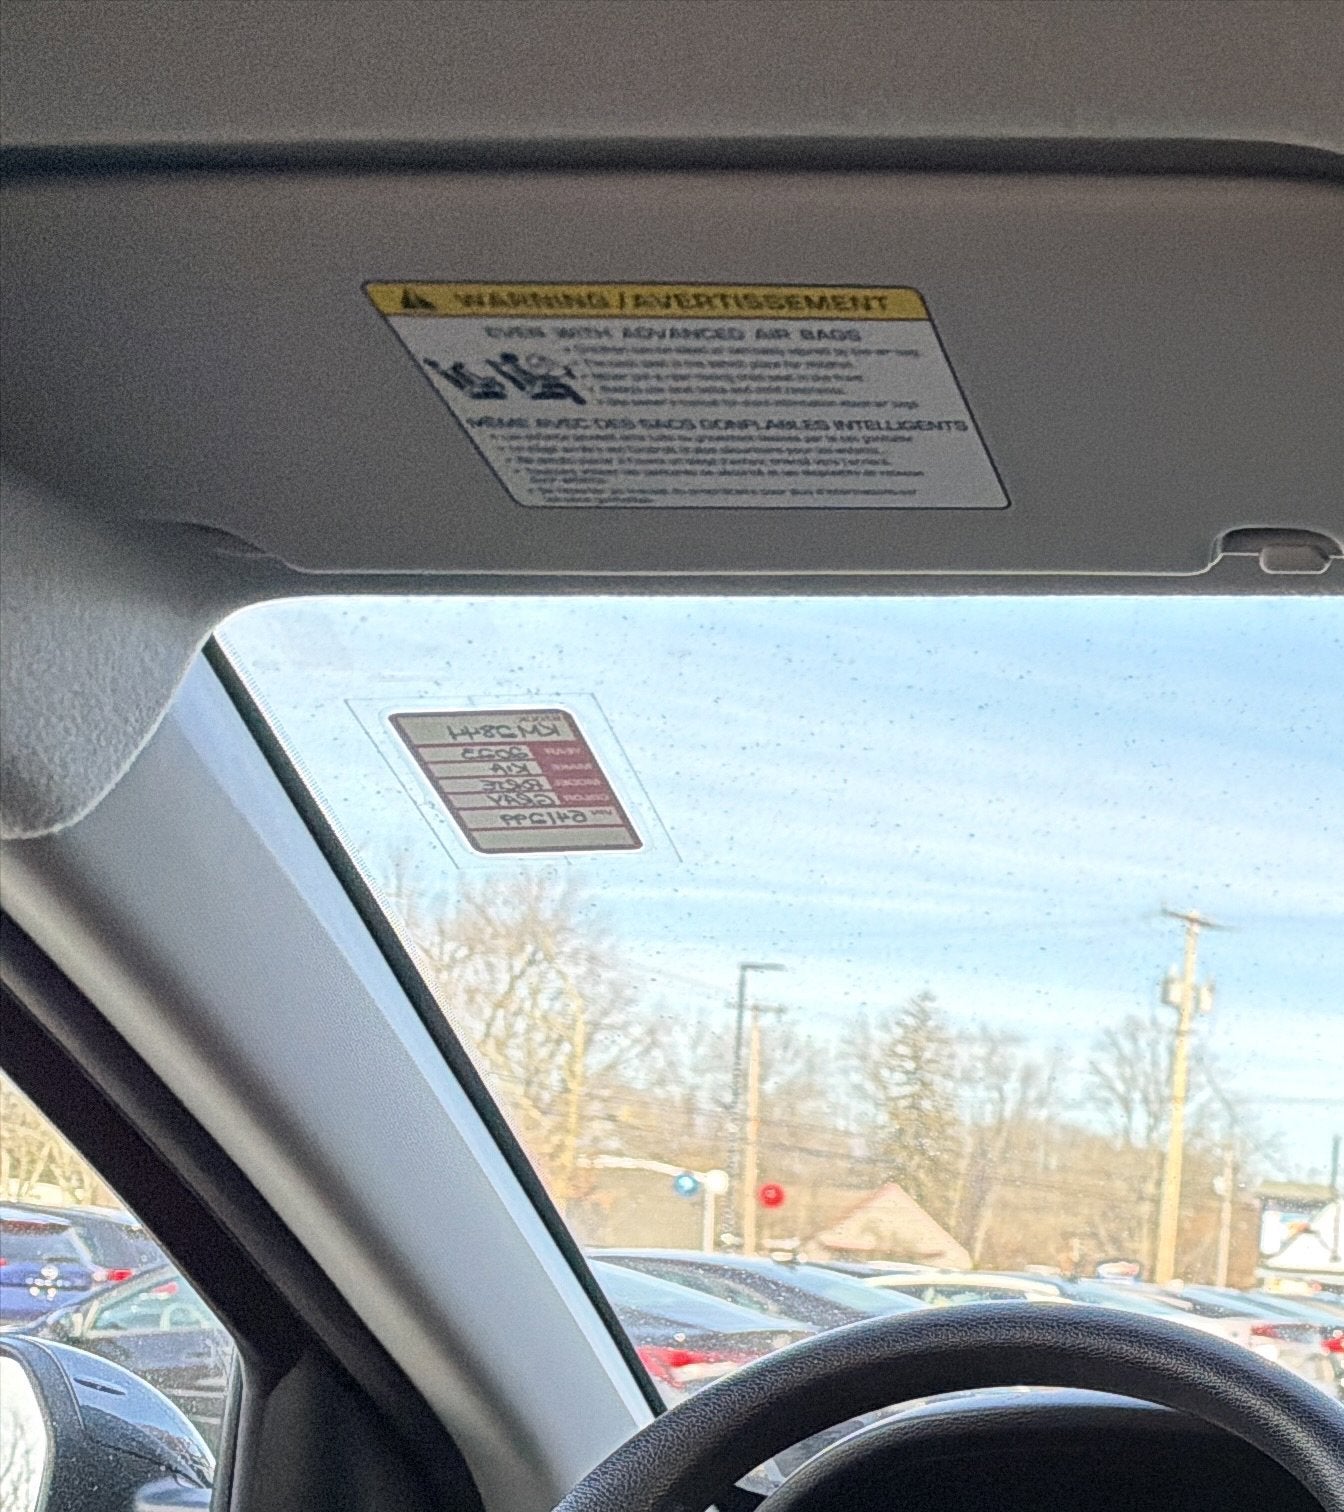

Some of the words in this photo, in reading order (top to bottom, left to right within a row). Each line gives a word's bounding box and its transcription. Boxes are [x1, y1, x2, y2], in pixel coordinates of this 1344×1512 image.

[622, 326, 746, 341] ADVANCED
[755, 327, 791, 341] AIR
[800, 328, 862, 343] BAGS
